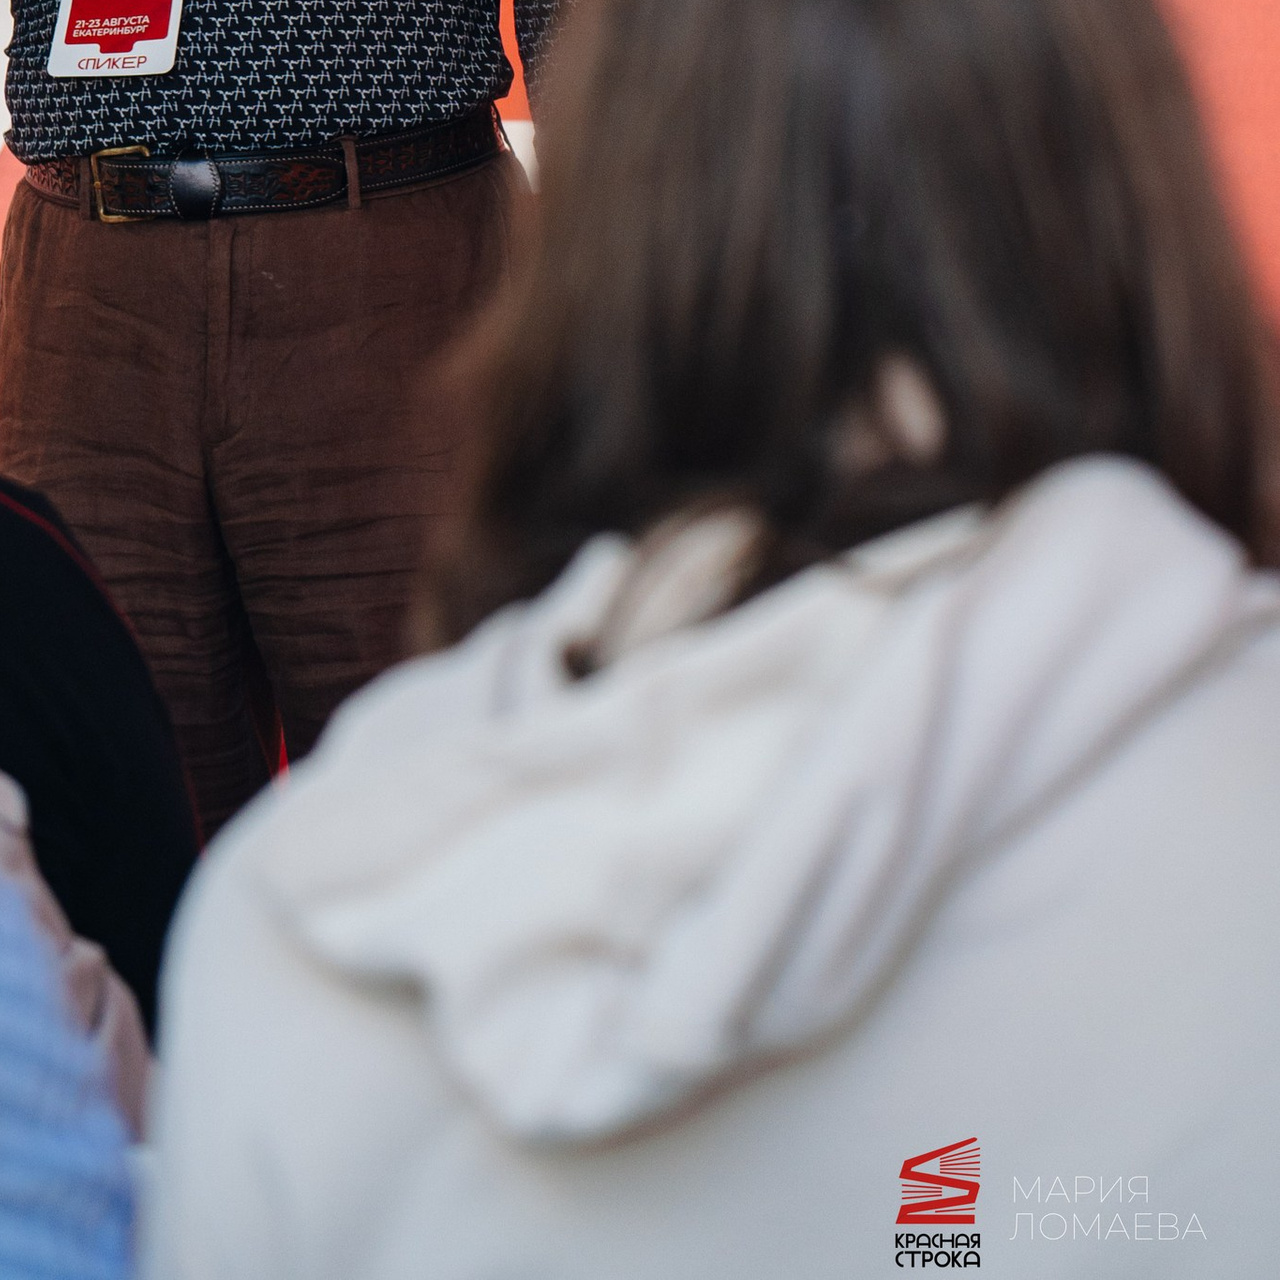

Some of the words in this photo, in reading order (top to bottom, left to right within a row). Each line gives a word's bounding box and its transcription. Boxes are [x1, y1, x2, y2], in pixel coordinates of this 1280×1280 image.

[75, 19, 101, 29] 21-23
[102, 15, 150, 28] АВГУСТА
[72, 24, 149, 38] ЕКАТЕРИНБУРГ
[78, 55, 148, 70] СПИКЕР
